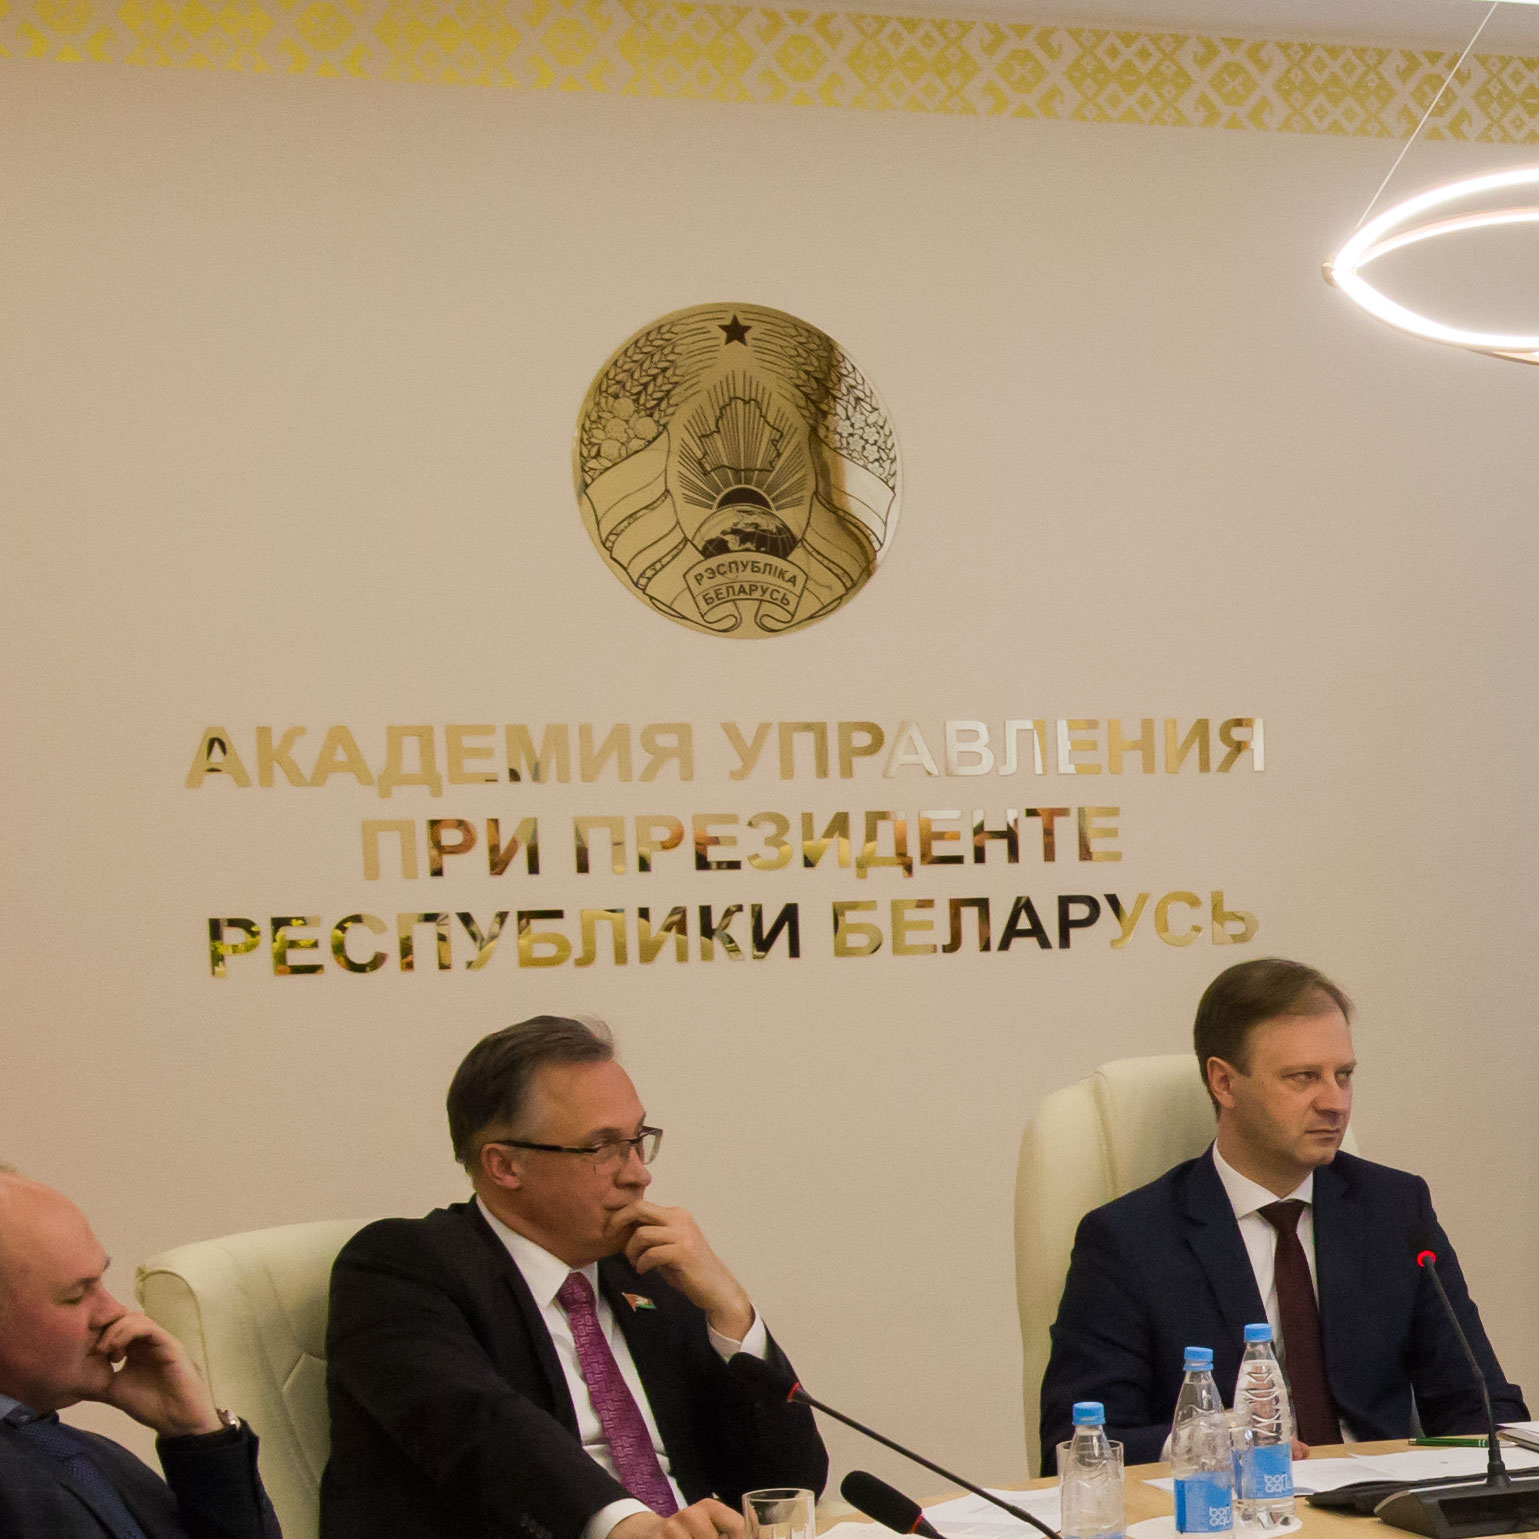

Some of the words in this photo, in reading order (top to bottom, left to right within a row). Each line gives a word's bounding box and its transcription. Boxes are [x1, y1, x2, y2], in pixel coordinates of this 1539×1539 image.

[694, 560, 797, 587] РЭСПУБЛІКА
[702, 584, 791, 606] БЕЛАРУСЬ
[183, 719, 696, 799] АКАДЕМИЯ
[719, 716, 1268, 783] УПРАВЛЕНИЯ
[360, 817, 540, 881] ПРИ
[573, 805, 1123, 879] ПРЕЗИДЕНТЕ
[205, 902, 800, 978] РЕСПУБЛИКИ
[831, 889, 1261, 958] БЕЛАРУСЬ
